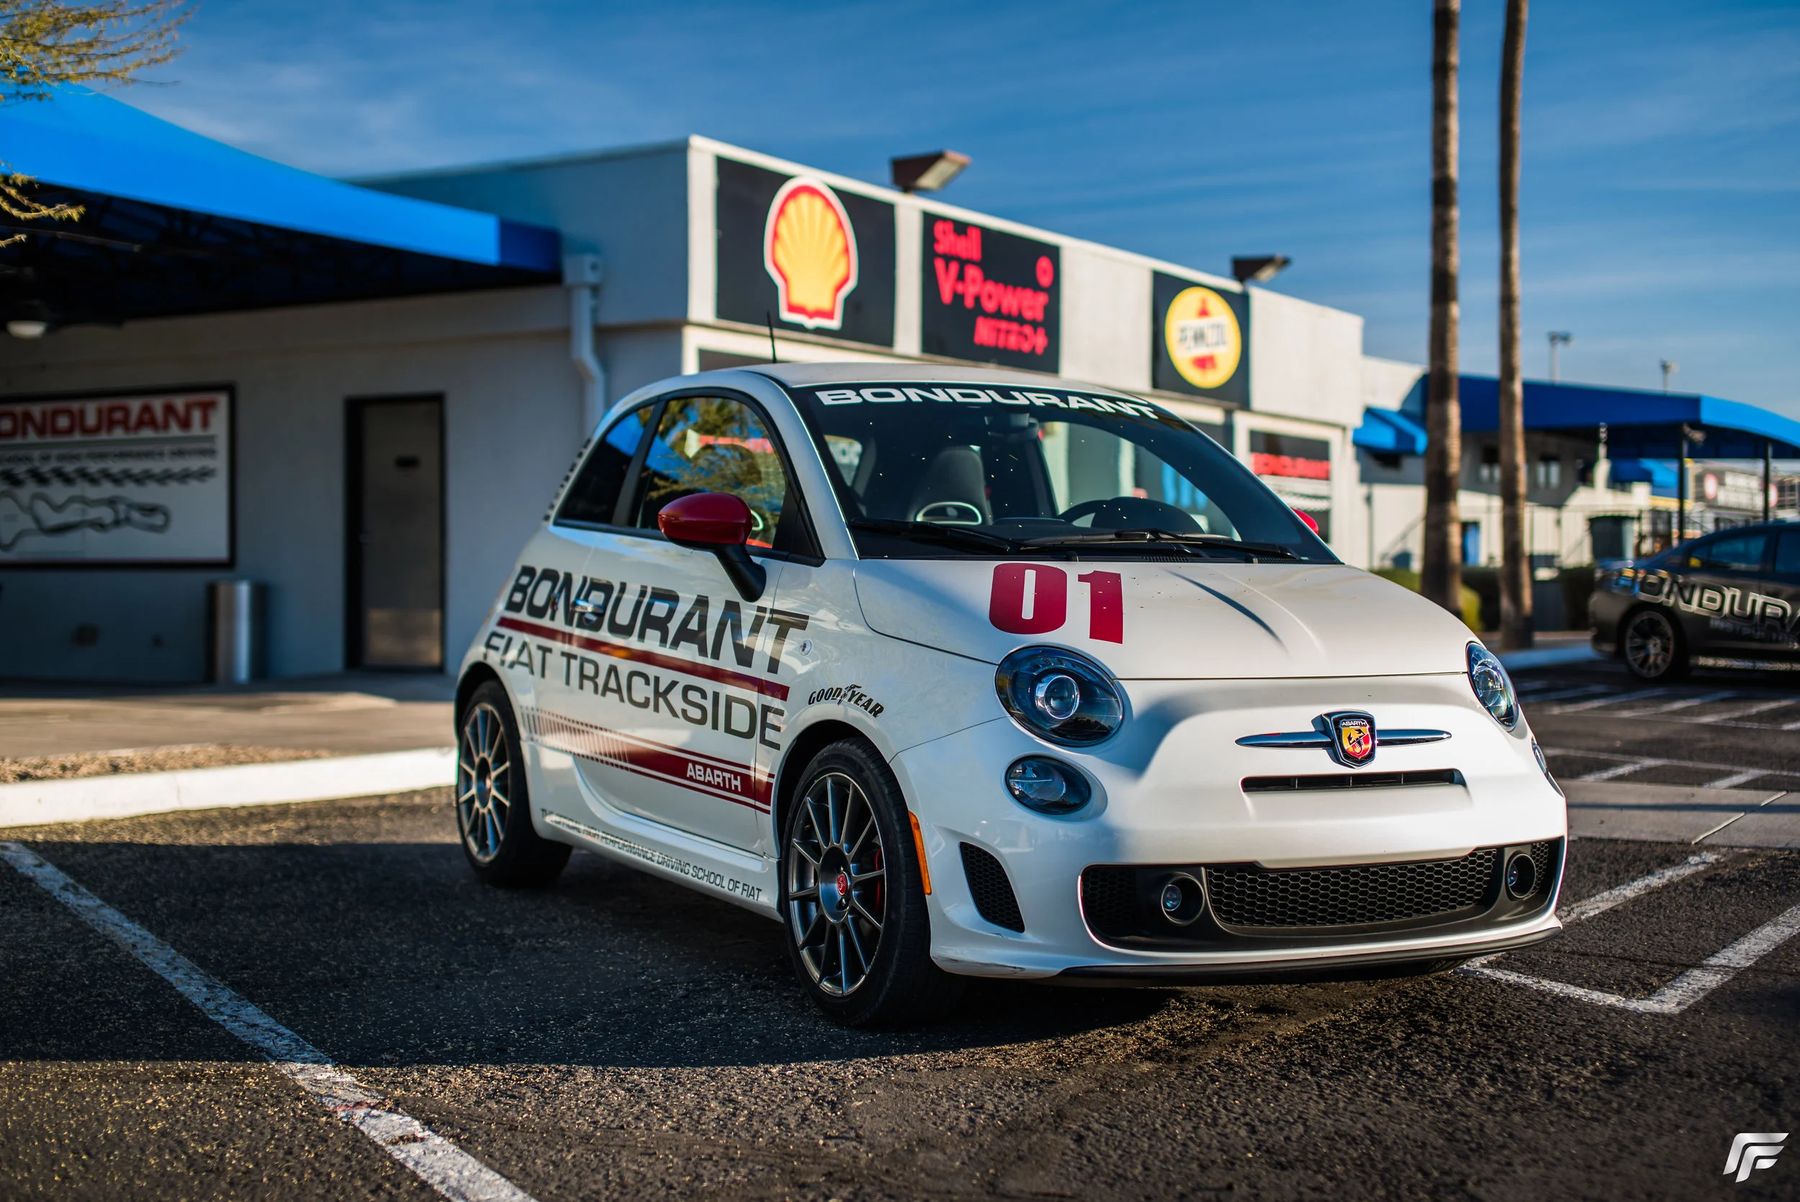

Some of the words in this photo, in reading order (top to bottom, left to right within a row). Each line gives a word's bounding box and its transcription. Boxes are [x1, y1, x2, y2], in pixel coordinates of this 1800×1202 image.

[933, 219, 982, 262] Shell
[933, 256, 1049, 322] V-Power
[813, 387, 1160, 420] BONDURANT
[504, 565, 809, 675] BONDURANT
[988, 562, 1123, 645] 01
[483, 631, 553, 679] FIAT
[560, 651, 785, 750] TRACKSIDE
[808, 686, 885, 718] GOODYEAR
[686, 762, 741, 792] ABARTH
[657, 851, 691, 875] DRIVING
[691, 865, 725, 888] SCHOOL
[727, 878, 741, 892] OF
[740, 882, 763, 902] FIAT
